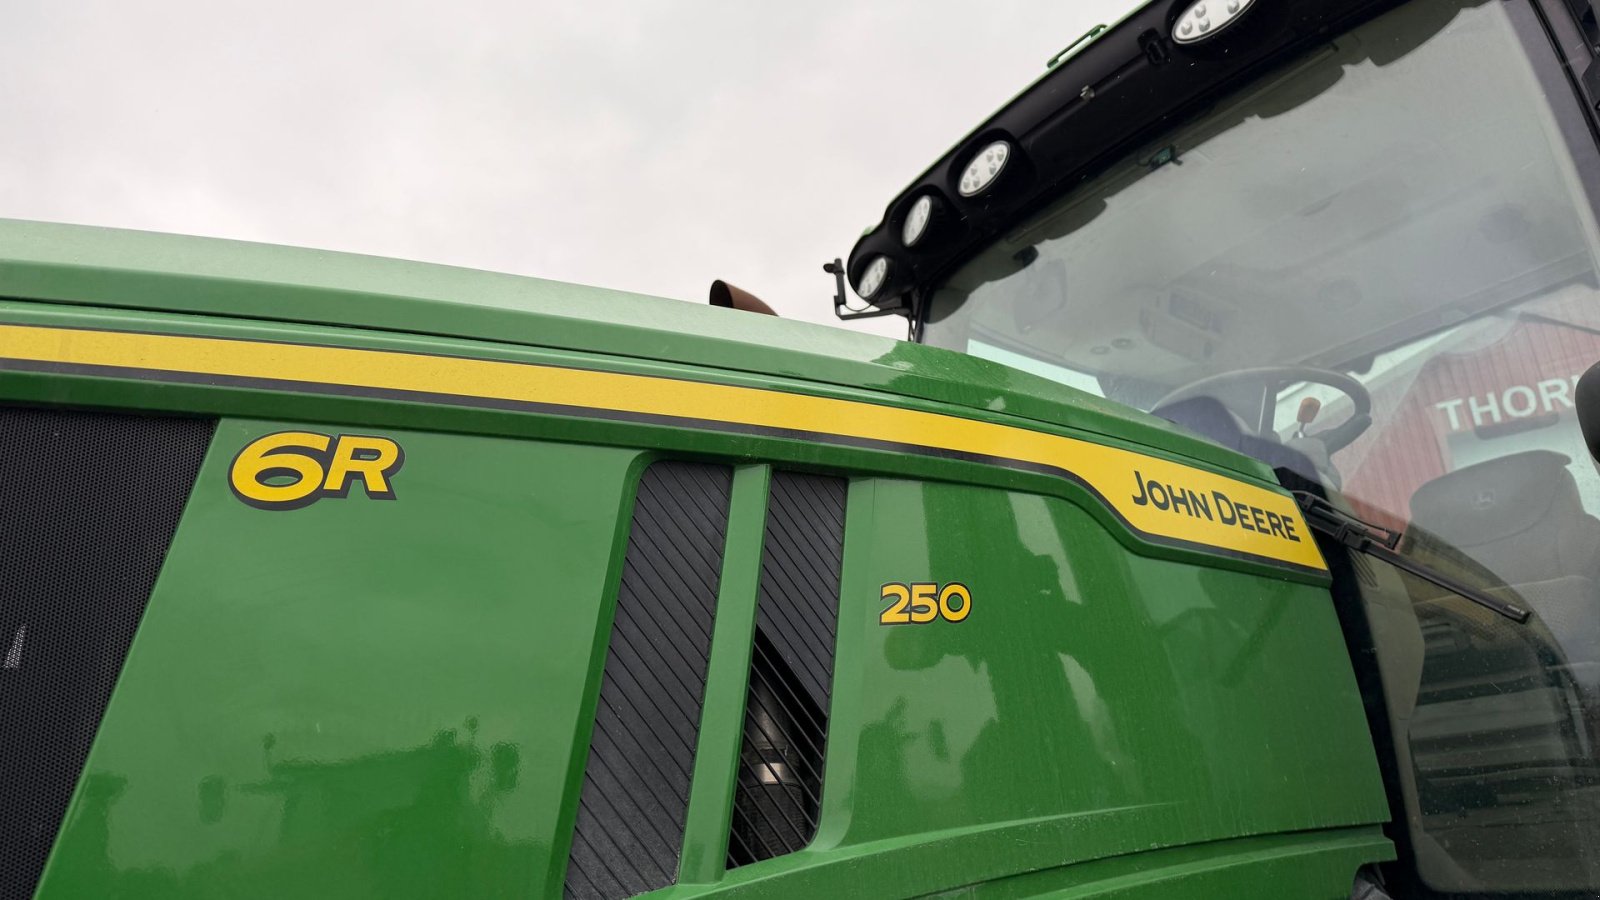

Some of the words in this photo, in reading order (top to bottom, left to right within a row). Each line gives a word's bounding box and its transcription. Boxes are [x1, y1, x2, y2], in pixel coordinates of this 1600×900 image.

[1435, 374, 1579, 430] THOR
[228, 430, 406, 511] 6R
[1132, 470, 1214, 521] JOHN
[1211, 490, 1301, 543] DEERE
[880, 582, 972, 626] 250
